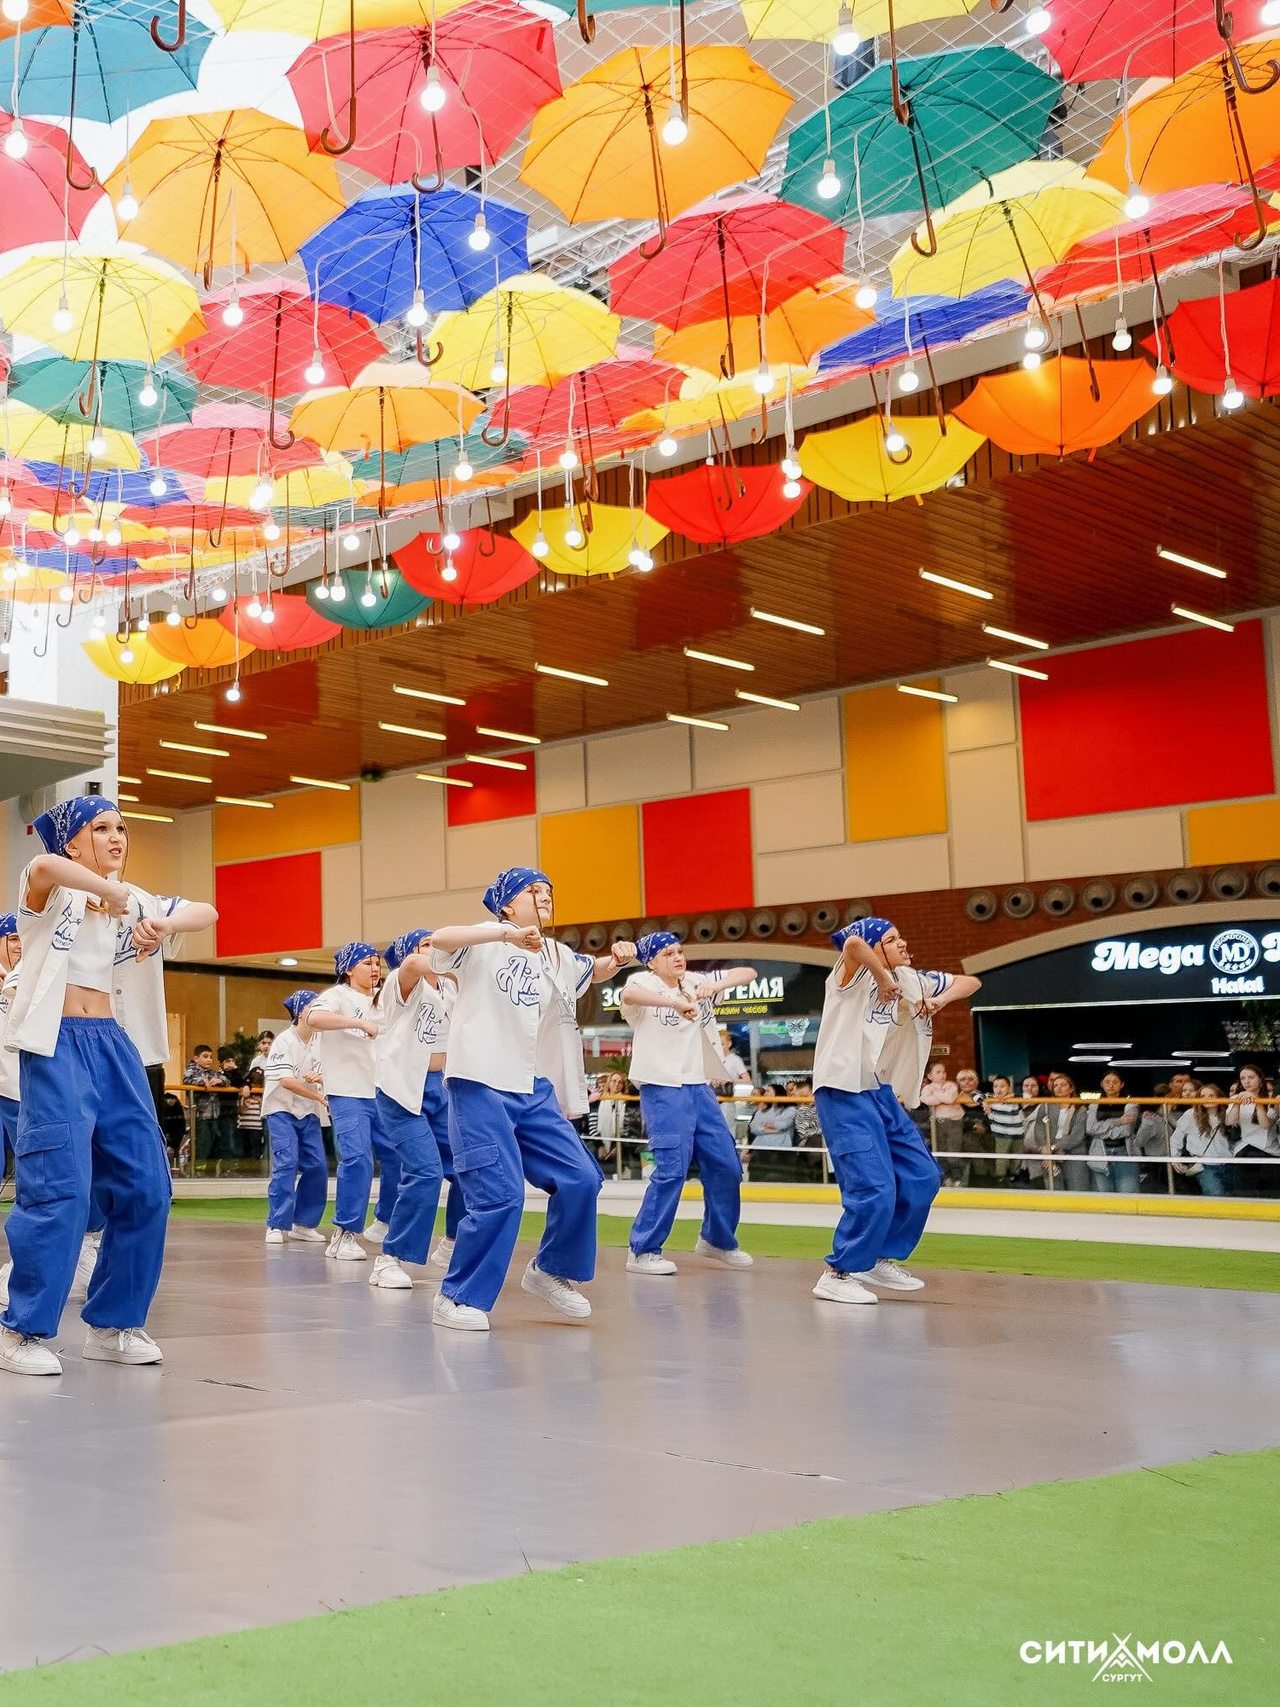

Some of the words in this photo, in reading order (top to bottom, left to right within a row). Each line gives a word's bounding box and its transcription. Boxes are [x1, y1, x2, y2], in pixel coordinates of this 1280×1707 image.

[1092, 941, 1205, 974] Mega
[1221, 942, 1251, 962] MD
[1211, 976, 1265, 994] Halal
